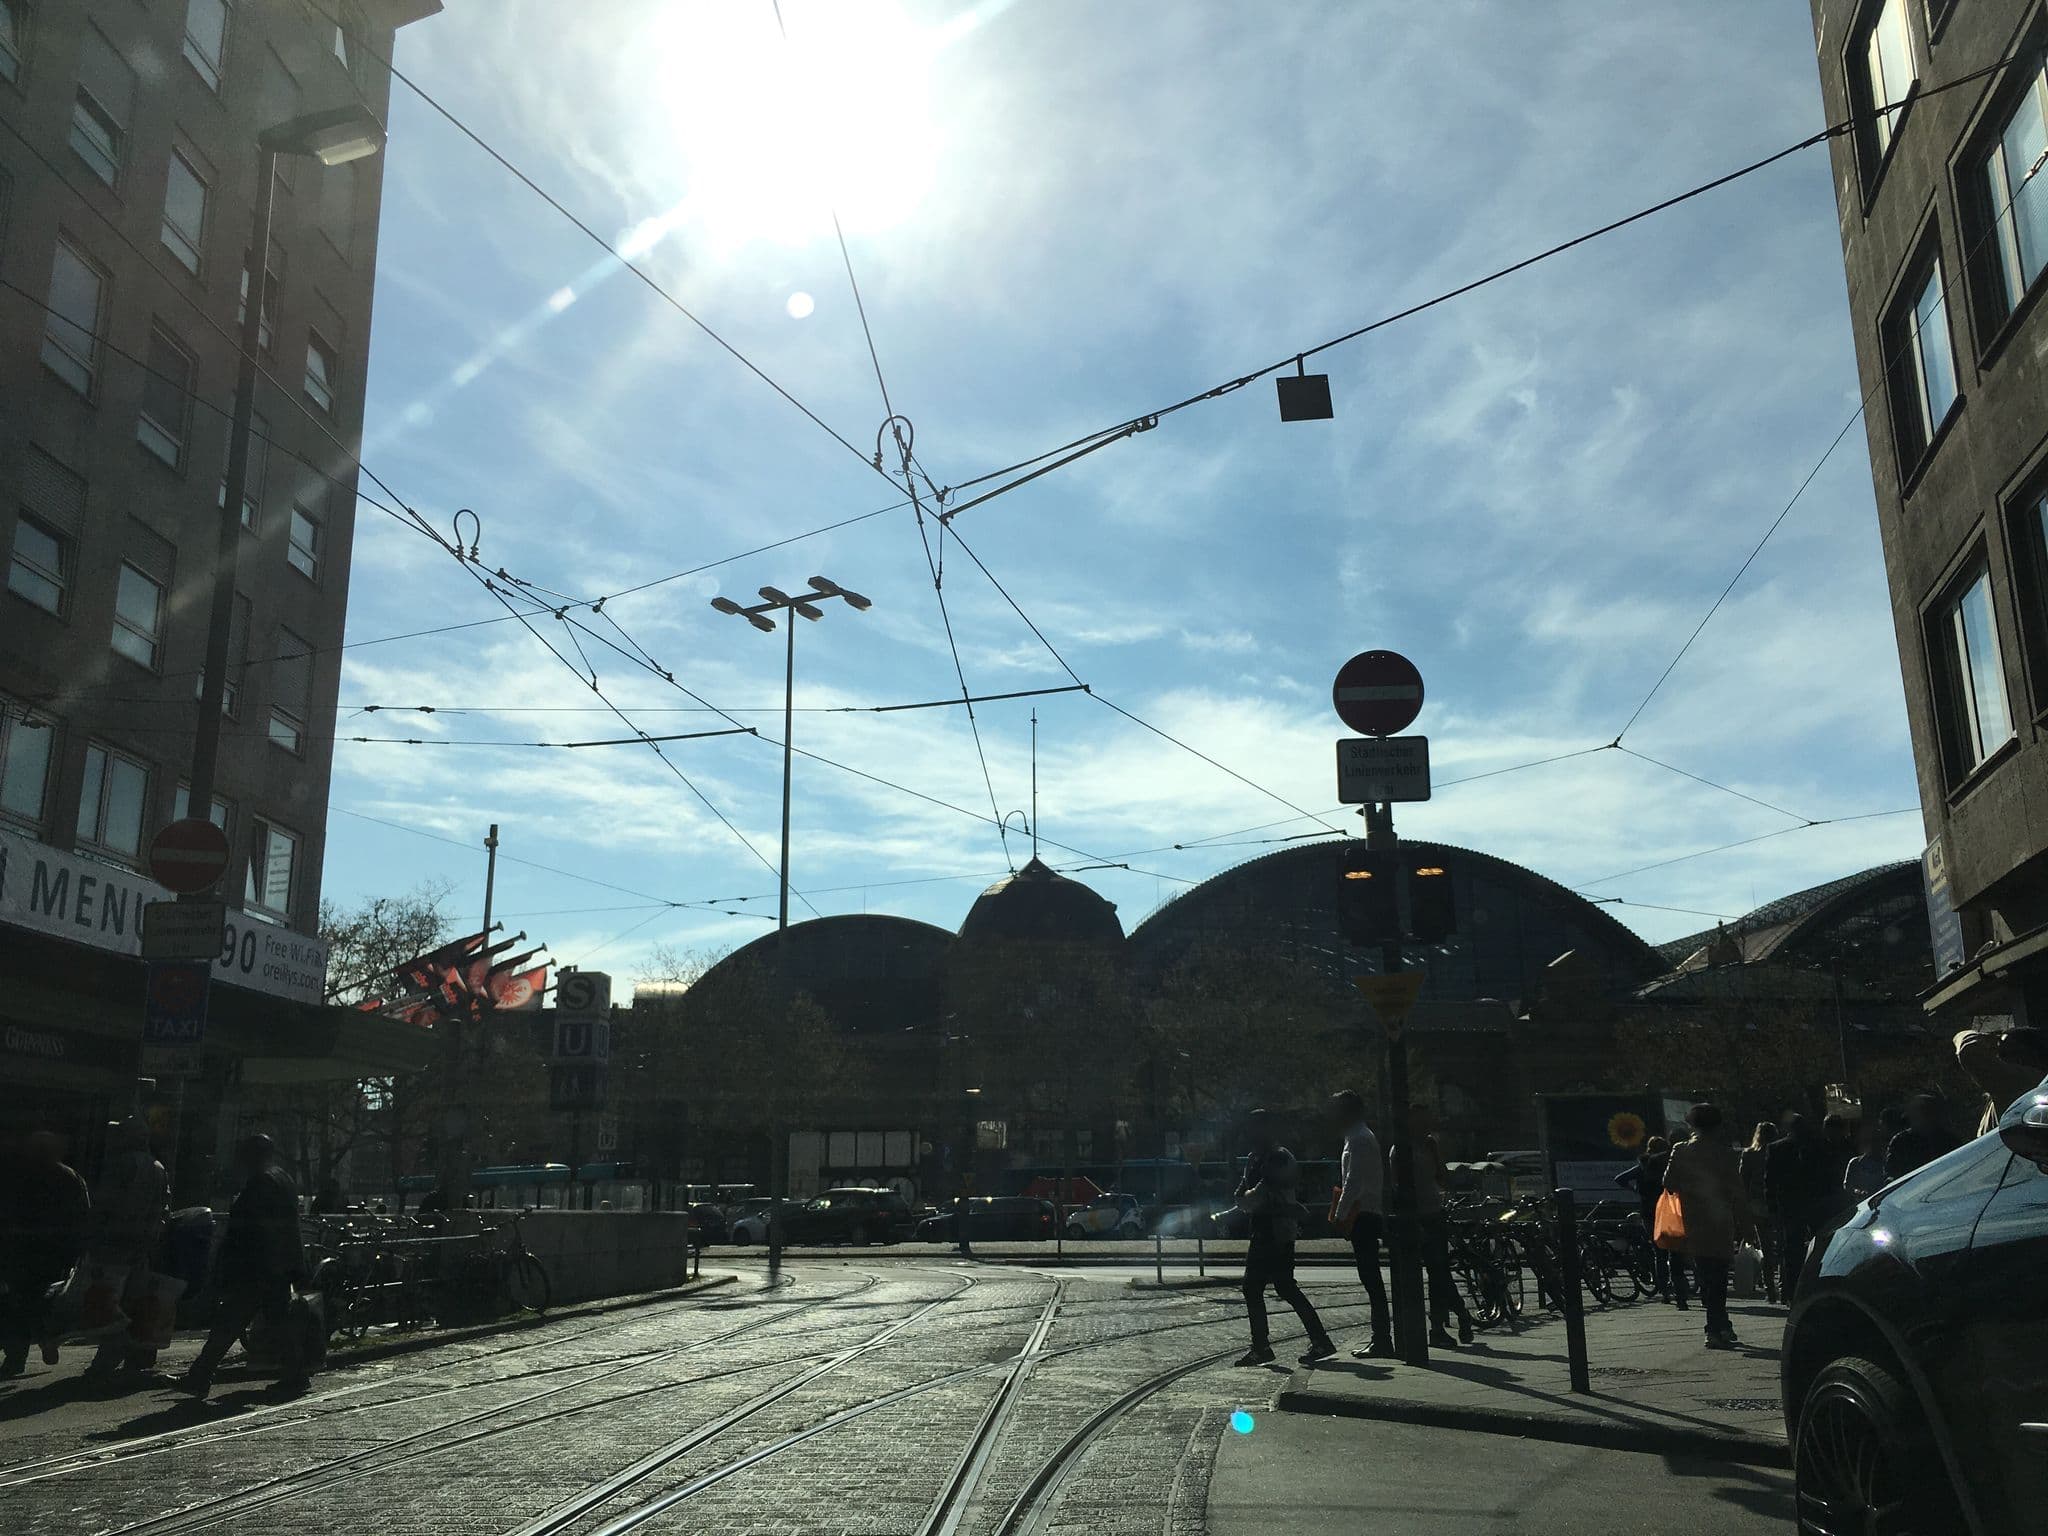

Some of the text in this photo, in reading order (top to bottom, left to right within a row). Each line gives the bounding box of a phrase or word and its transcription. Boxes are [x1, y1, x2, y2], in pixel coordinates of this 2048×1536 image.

[264, 934, 288, 959] Free
[565, 978, 590, 1009] S
[151, 1017, 198, 1037] TAXI
[565, 1025, 586, 1055] U
